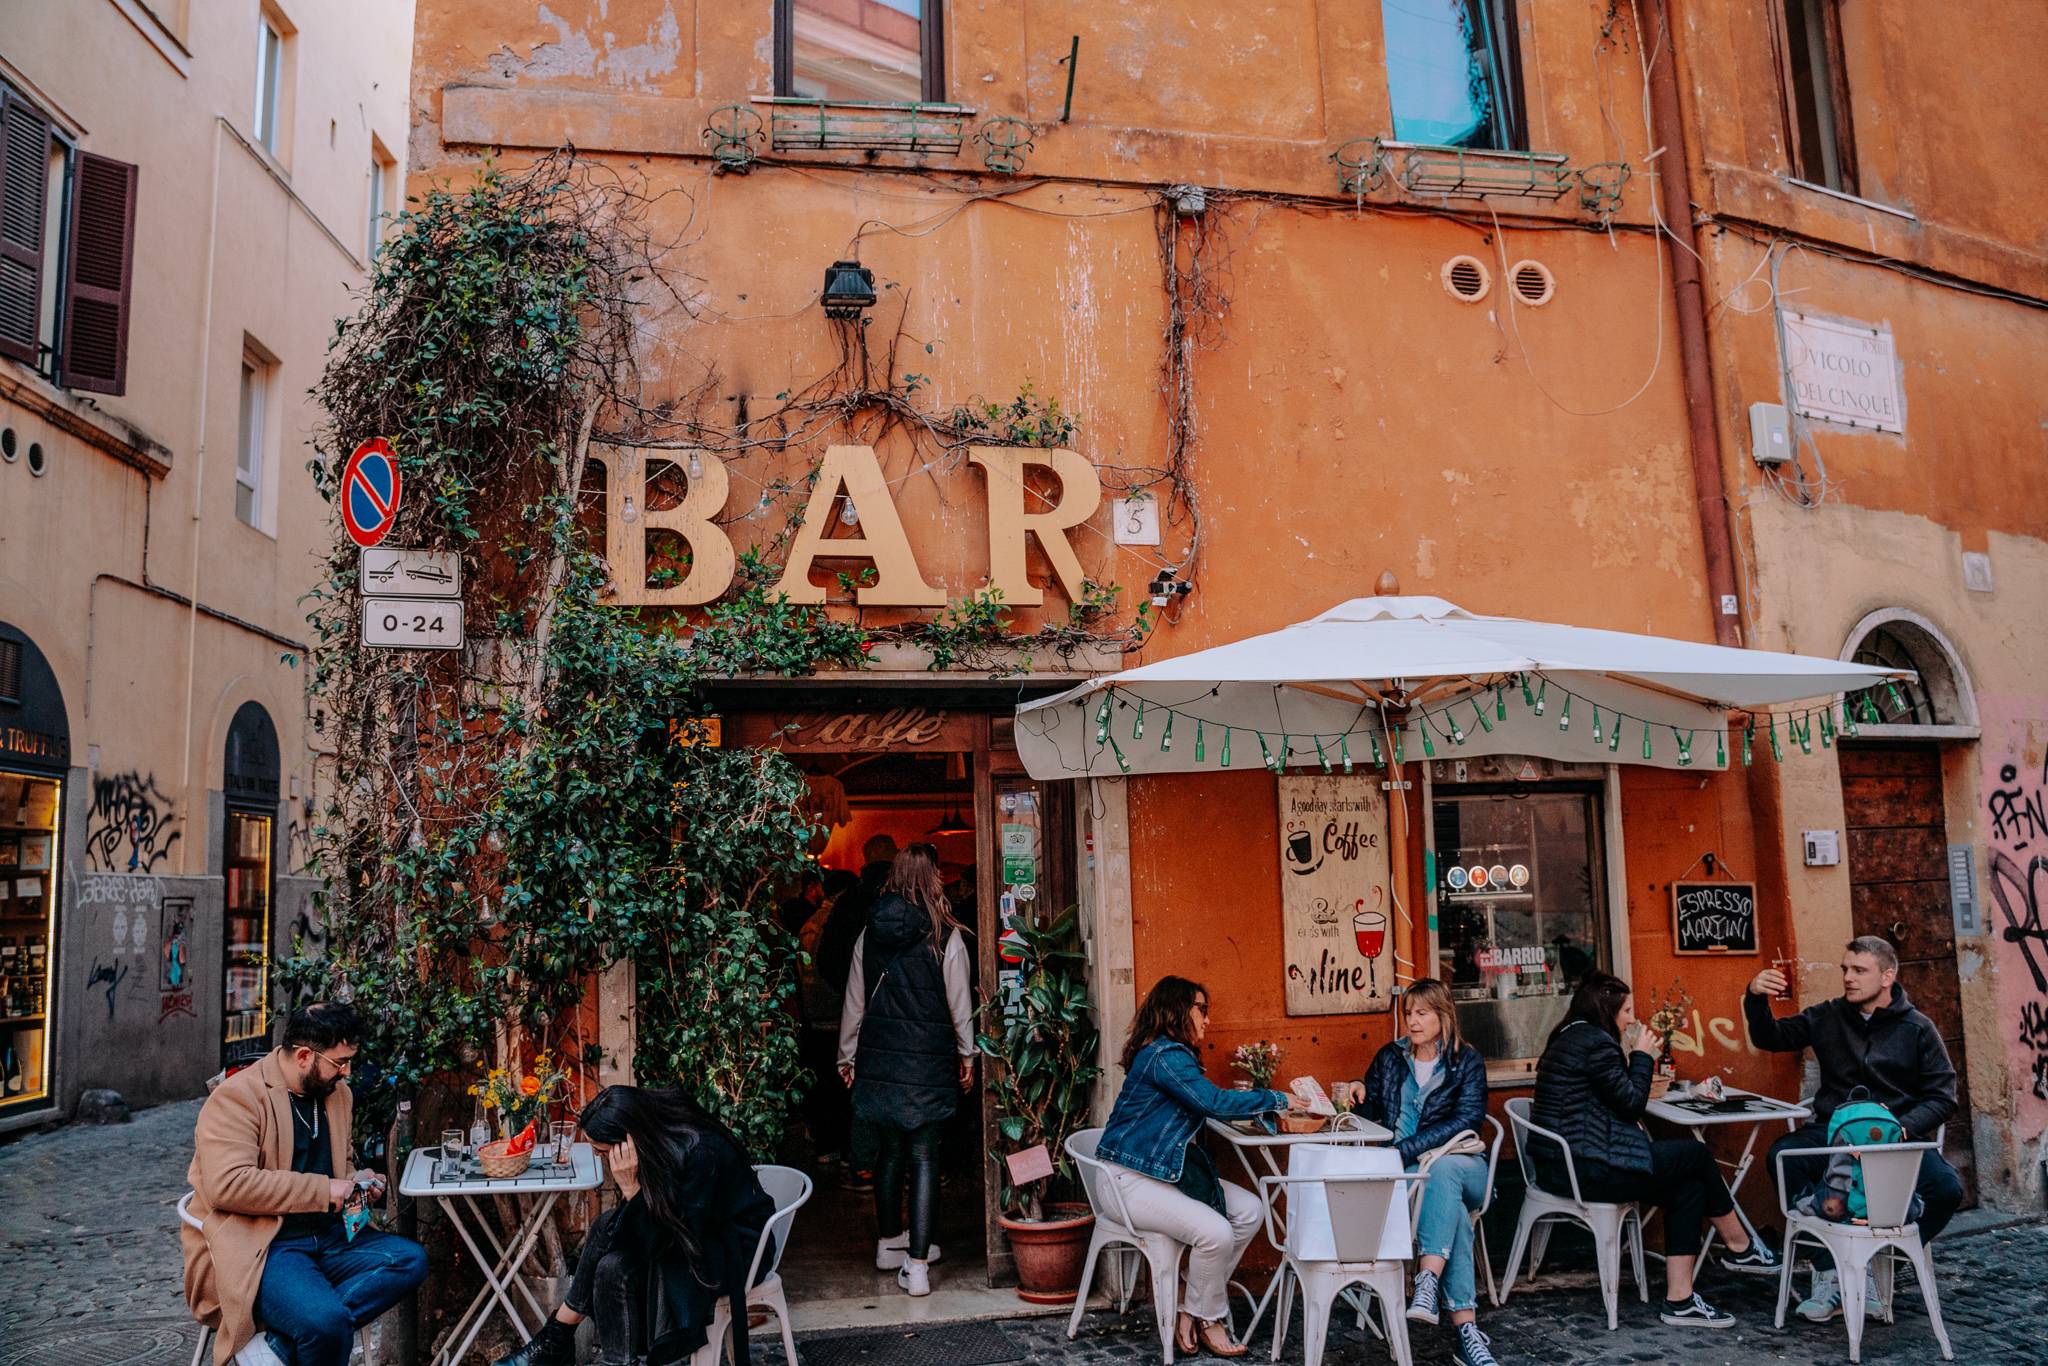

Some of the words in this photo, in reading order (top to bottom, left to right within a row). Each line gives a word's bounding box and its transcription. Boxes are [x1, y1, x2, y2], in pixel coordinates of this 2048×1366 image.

[1808, 348, 1872, 378] VICOLO
[1796, 380, 1826, 403] DEL
[1828, 386, 1892, 416] CINQUE
[588, 445, 1103, 609] BAR
[1126, 508, 1145, 535] 5
[382, 614, 445, 634] 0-24
[1297, 797, 1314, 817] good
[1323, 821, 1379, 861] Coffee
[1677, 889, 1751, 920] ESPRESSO
[1297, 926, 1319, 938] es
[1321, 926, 1340, 938] with
[1493, 946, 1545, 966] BARRIO
